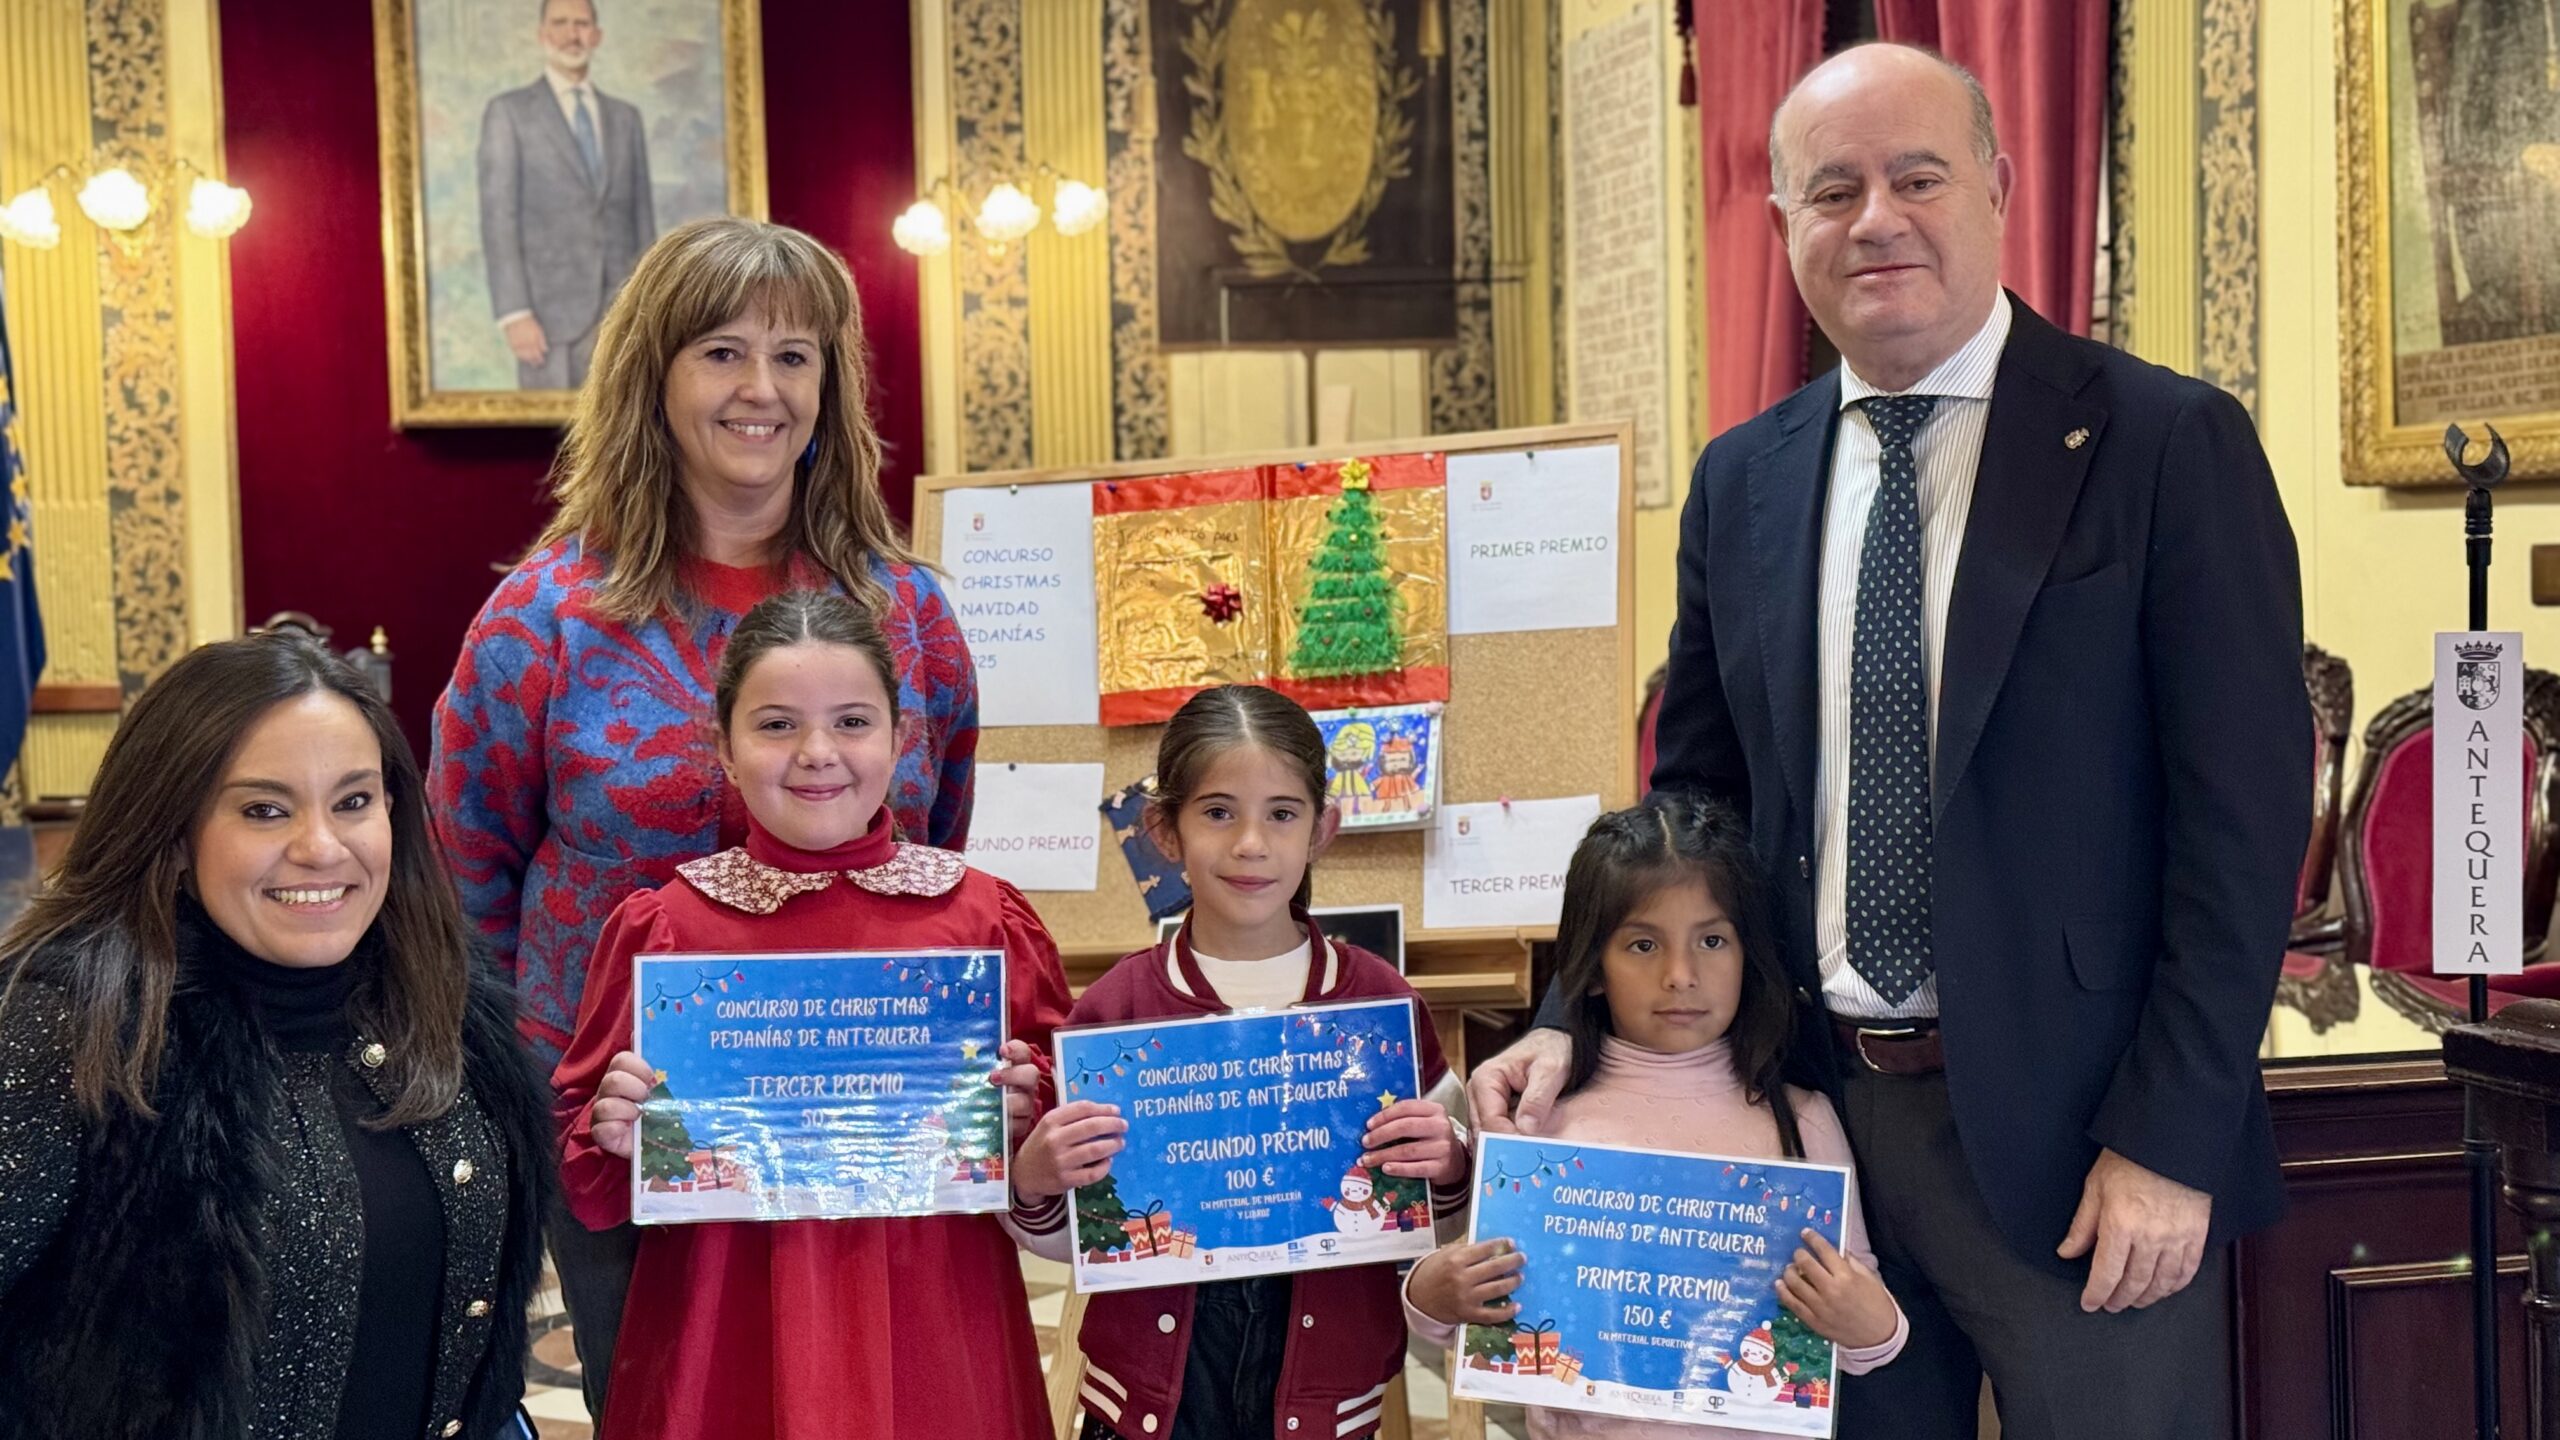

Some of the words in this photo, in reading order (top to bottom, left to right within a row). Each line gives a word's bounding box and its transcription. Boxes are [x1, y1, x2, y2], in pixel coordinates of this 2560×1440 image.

[962, 548, 1053, 563] CONCURSO
[1471, 541, 1535, 559] PRIMER
[1539, 536, 1608, 555] PREMIO
[961, 574, 1061, 590] CHRISTMAS
[960, 601, 1039, 616] NAVIDAD
[967, 837, 1024, 851] GUNDO
[1028, 835, 1094, 850] PREMIO
[2465, 720, 2494, 963] ANTEQUERA
[1450, 877, 1514, 894] TERCER
[1519, 873, 1567, 891] PREM
[717, 997, 799, 1020] CONCURSO
[803, 999, 826, 1017] DE
[831, 997, 928, 1018] CHRISTMAS
[710, 1025, 791, 1049] PEDANÍAS
[798, 1029, 819, 1047] DE
[826, 1026, 930, 1046] ANTEQUERA
[1137, 1065, 1219, 1087] CONCURSO
[1222, 1060, 1245, 1078] DE
[1249, 1050, 1343, 1077] CHRISTMAS
[744, 1075, 827, 1097] TERCER
[833, 1073, 904, 1096] PREMIO
[1134, 1092, 1213, 1118] PEDANÍAS
[1218, 1091, 1241, 1109] DE
[1247, 1079, 1348, 1105] ANTEQUERA
[1166, 1136, 1256, 1164] SEGUNDO
[1262, 1127, 1330, 1154] PREMIO
[1225, 1168, 1257, 1190] 100
[1262, 1167, 1275, 1186] €
[1552, 1185, 1635, 1212] CONCURSO
[1638, 1194, 1662, 1214] DE
[1666, 1197, 1766, 1225] CHRISTMAS
[1544, 1214, 1627, 1241] PEDANÍAS
[1630, 1223, 1654, 1243] DE
[1659, 1228, 1766, 1256] ANTEQUERA
[1576, 1266, 1651, 1295] PRIMER
[1658, 1274, 1730, 1302] PREMIO
[1623, 1304, 1654, 1328] 150
[1659, 1309, 1673, 1330] €
